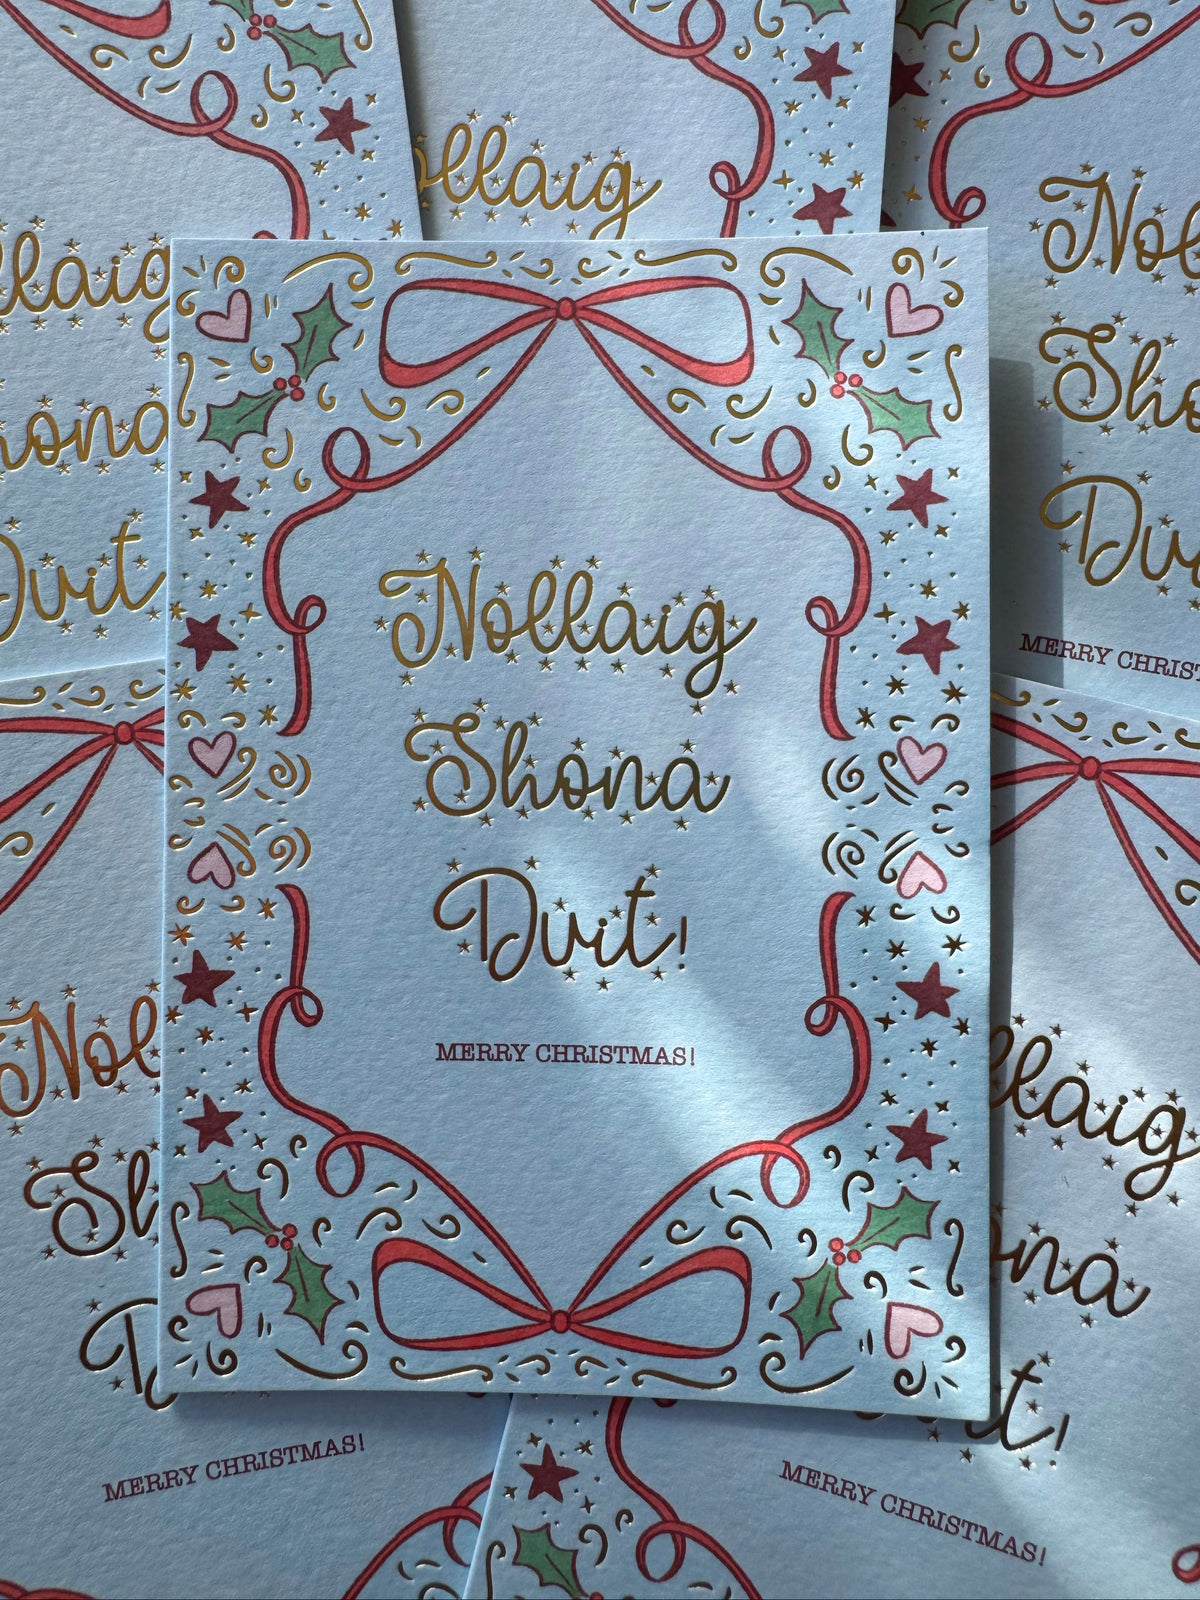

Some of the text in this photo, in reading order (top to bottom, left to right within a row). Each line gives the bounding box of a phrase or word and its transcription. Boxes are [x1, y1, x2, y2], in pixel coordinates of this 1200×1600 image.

[380, 558, 757, 699] Nollaig
[1019, 633, 1113, 664] MERRY
[405, 712, 730, 817] Shona
[435, 1042, 695, 1066] MERRY CHRISTMAS!
[102, 1433, 365, 1502] MERRY CHRISTMAS!
[779, 1460, 1047, 1567] MERRY CHRISTMAS!
